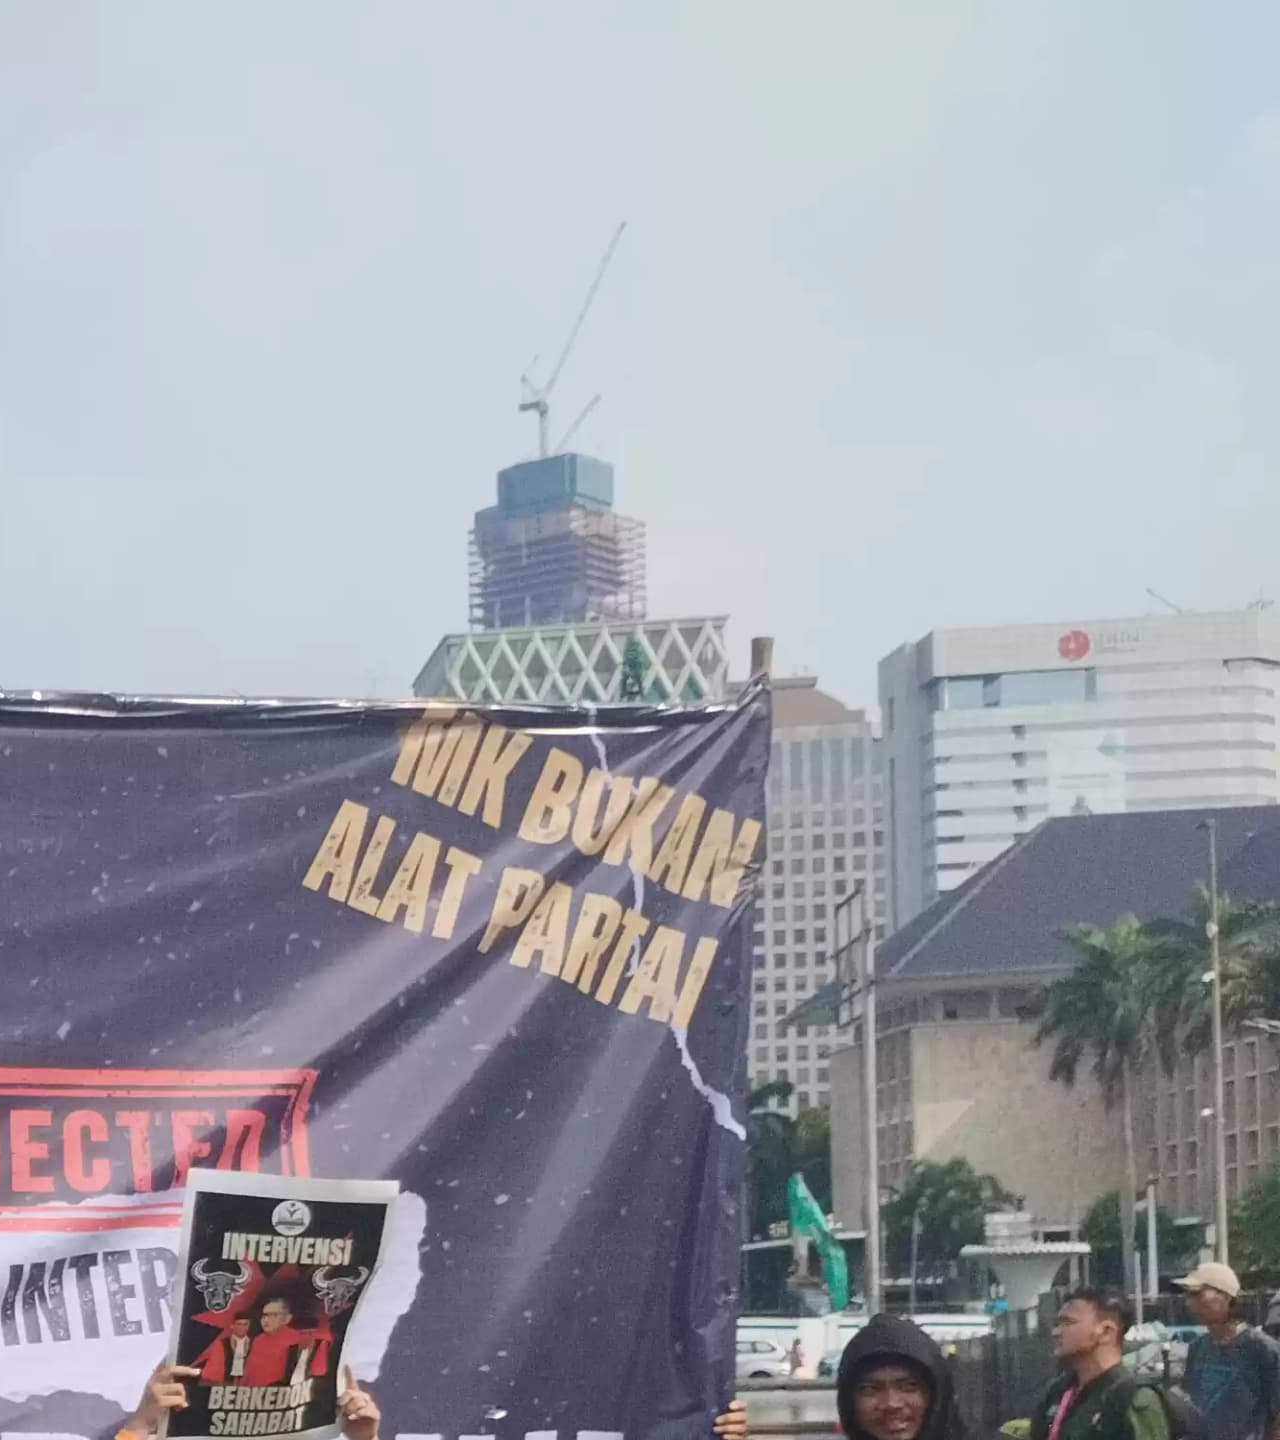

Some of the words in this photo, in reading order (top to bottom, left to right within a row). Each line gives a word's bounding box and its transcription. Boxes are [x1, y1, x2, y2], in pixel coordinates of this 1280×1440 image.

[390, 706, 535, 830] MK
[517, 747, 762, 909] BUKAN
[302, 799, 483, 940] ALAT
[477, 867, 719, 1028] PARTAI
[222, 1231, 354, 1266] INTERVENSI
[0, 1247, 181, 1346] INTER
[208, 1377, 314, 1410] BERKEDOK
[209, 1404, 306, 1435] SAHABAT
